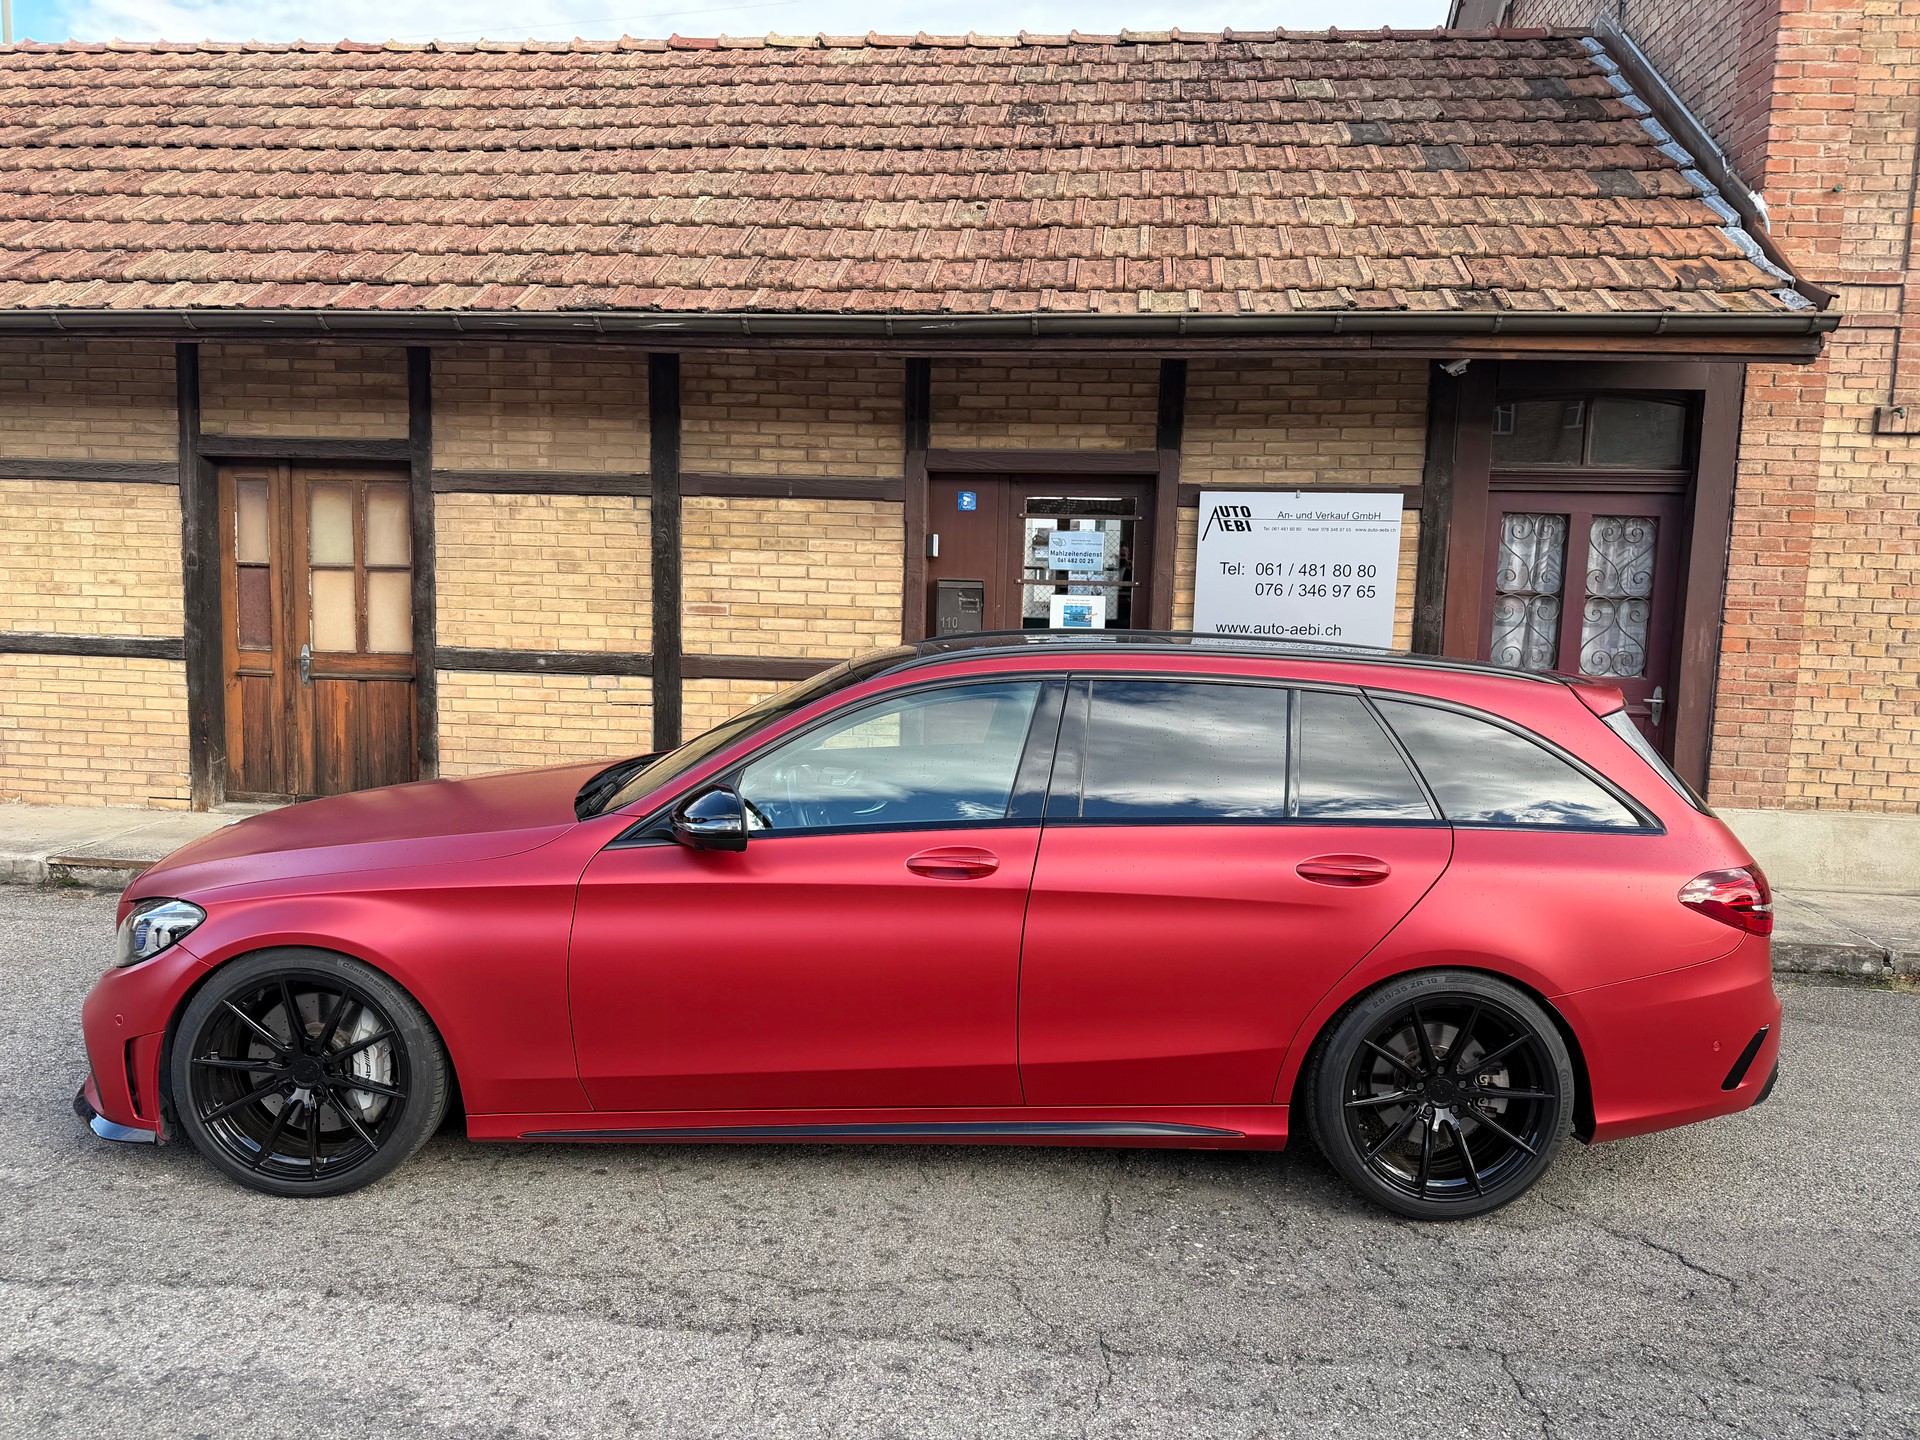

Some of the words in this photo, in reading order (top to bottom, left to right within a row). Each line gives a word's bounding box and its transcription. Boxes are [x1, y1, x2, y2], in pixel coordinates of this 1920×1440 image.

[1277, 511, 1293, 519] An-
[1296, 511, 1313, 519] und
[1315, 511, 1350, 520] Verkauf
[1352, 512, 1382, 520] GmbH
[1050, 550, 1102, 558] Mahlzeitendienst
[1220, 562, 1245, 576] Tel:
[1255, 562, 1282, 576] 061
[1288, 563, 1295, 577] /
[1298, 563, 1326, 577] 481
[1332, 564, 1352, 578] 80
[1357, 564, 1377, 578] 80
[1255, 583, 1283, 597] 076
[1288, 583, 1295, 597] /
[1298, 583, 1327, 598] 346
[1332, 584, 1351, 598] 97
[1356, 585, 1376, 599] 65
[940, 616, 958, 628] 110
[1215, 622, 1342, 637] www.auto-aebi.ch
[1372, 985, 1408, 1009] 255/35
[1409, 980, 1424, 989] ZR
